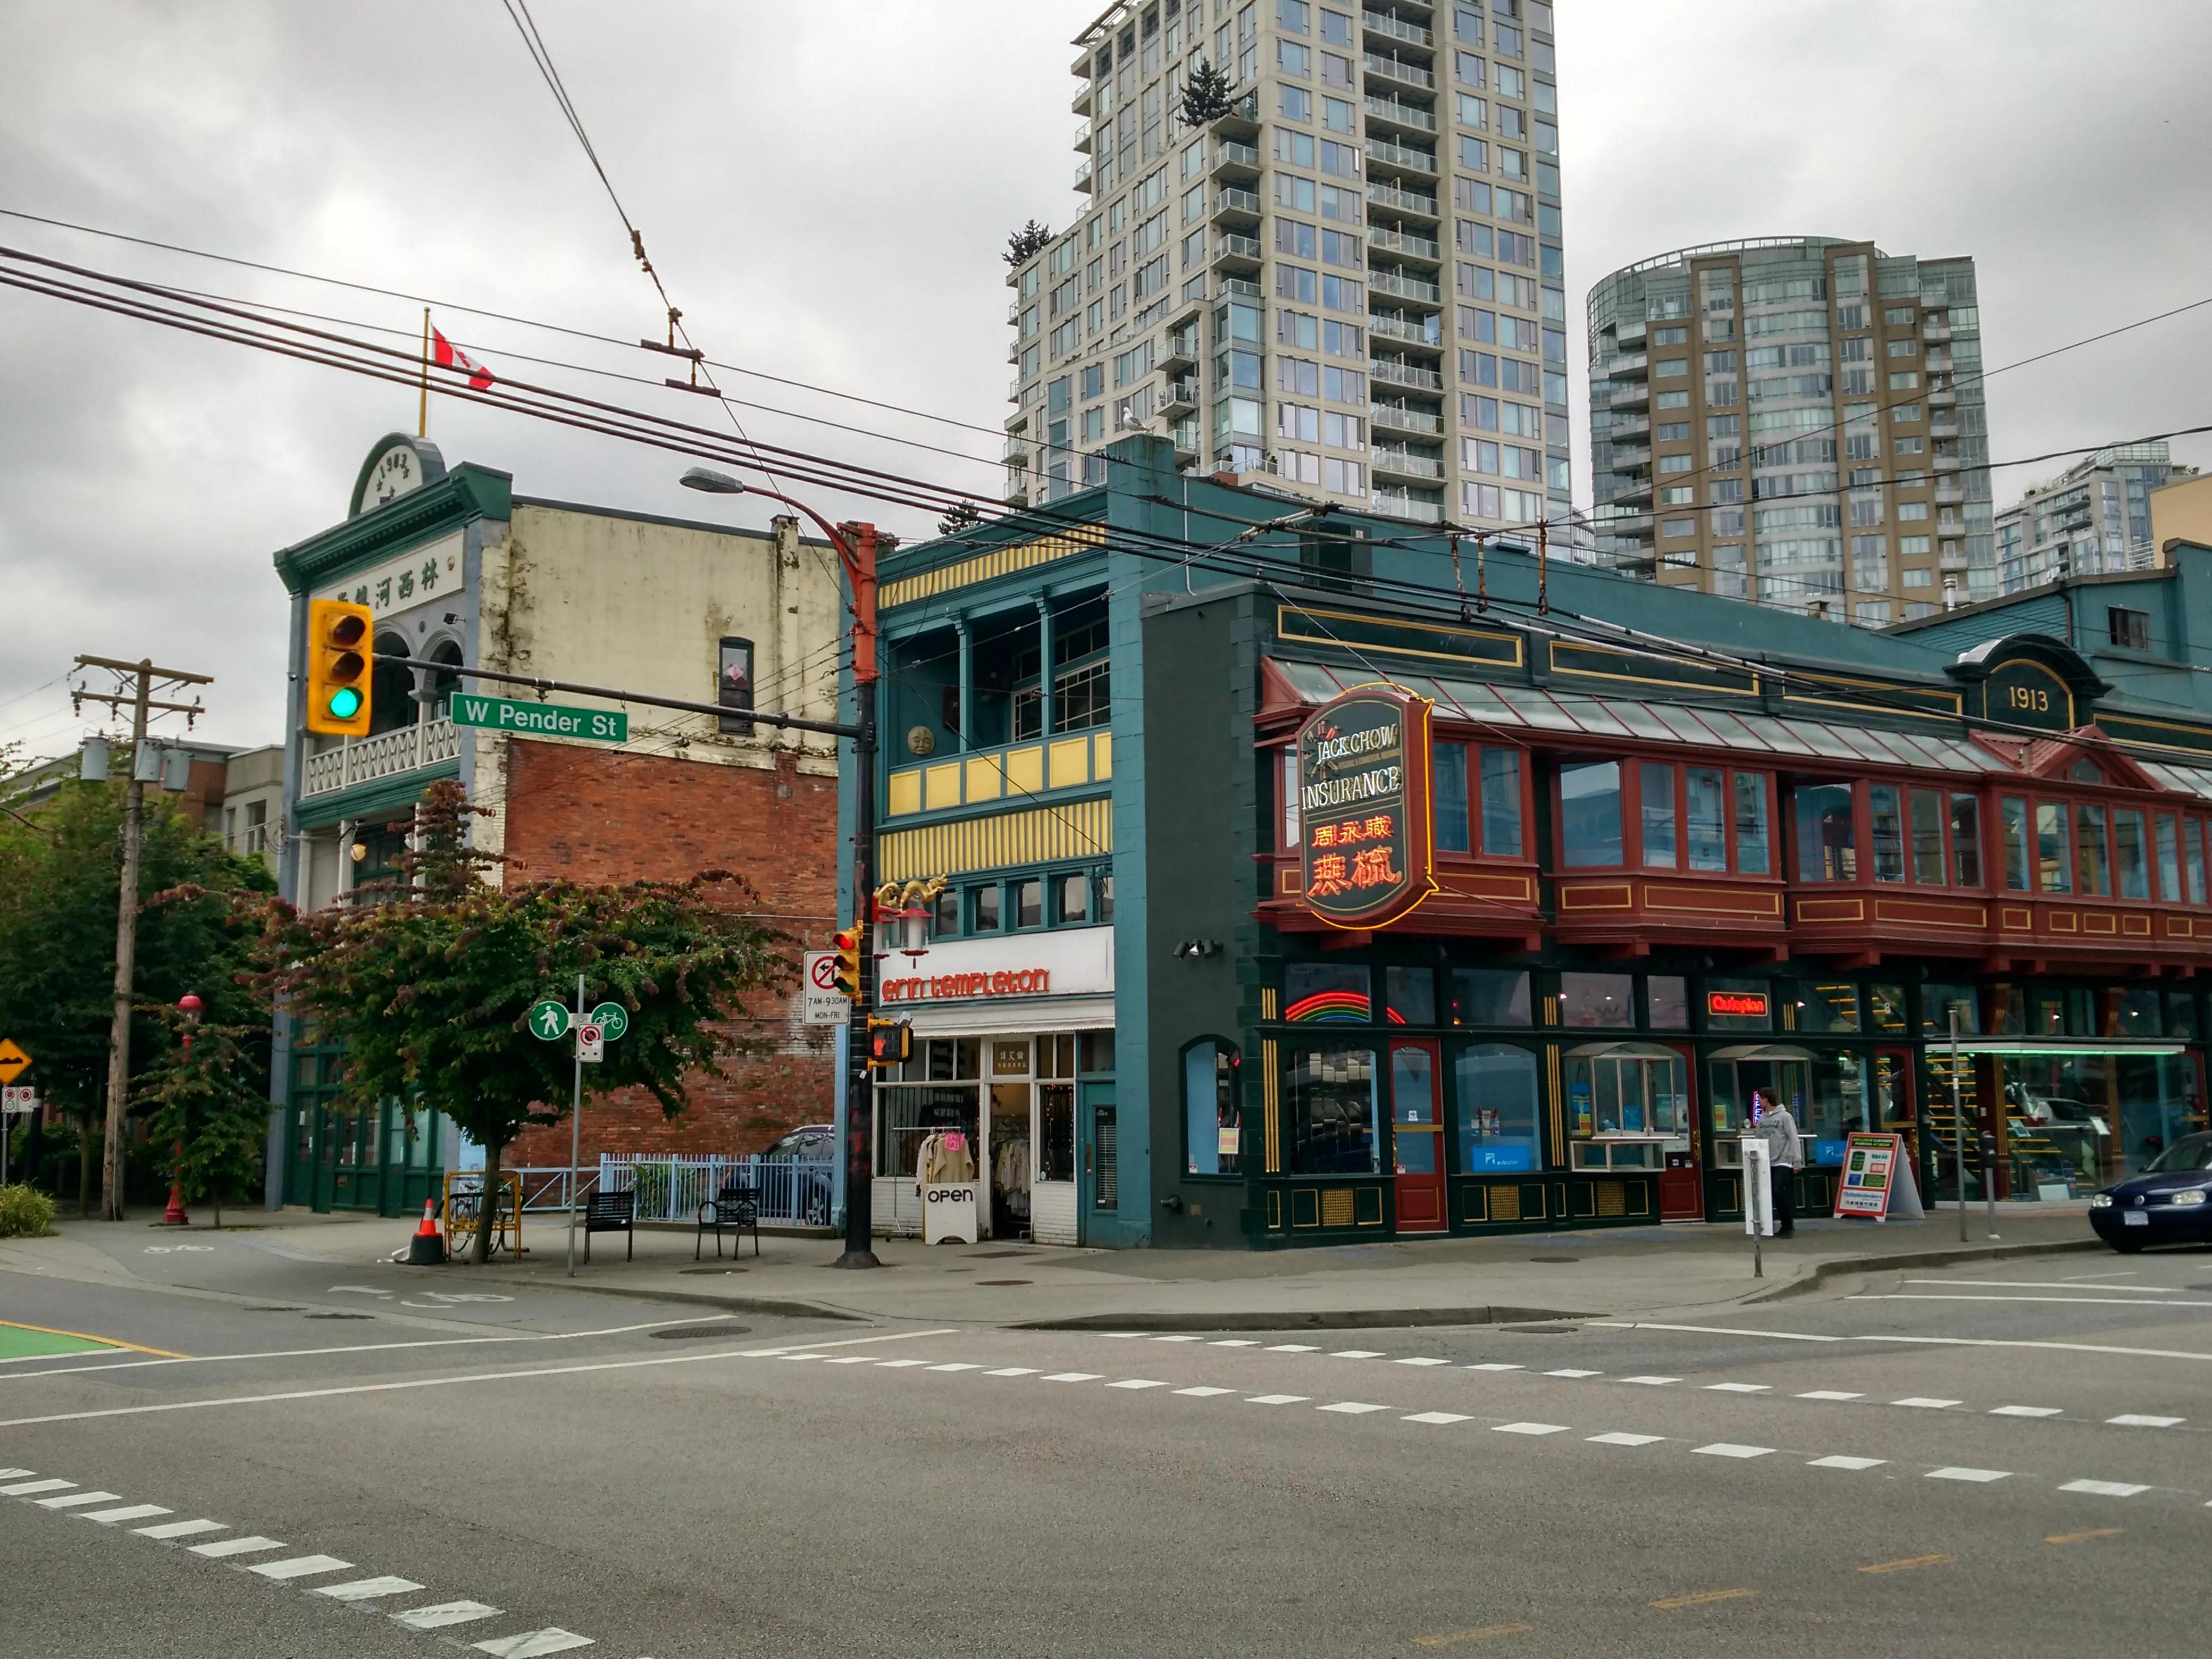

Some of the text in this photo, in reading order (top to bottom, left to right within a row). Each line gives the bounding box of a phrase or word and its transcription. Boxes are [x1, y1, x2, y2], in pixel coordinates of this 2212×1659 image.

[2010, 686, 2048, 711] 1913
[465, 700, 616, 736] W Pender St
[1316, 736, 1351, 765] JACK
[1351, 724, 1397, 752] CHOW
[1301, 766, 1401, 809] INSURANCE
[882, 977, 924, 1001] erin
[1884, 1002, 1891, 1013] 8
